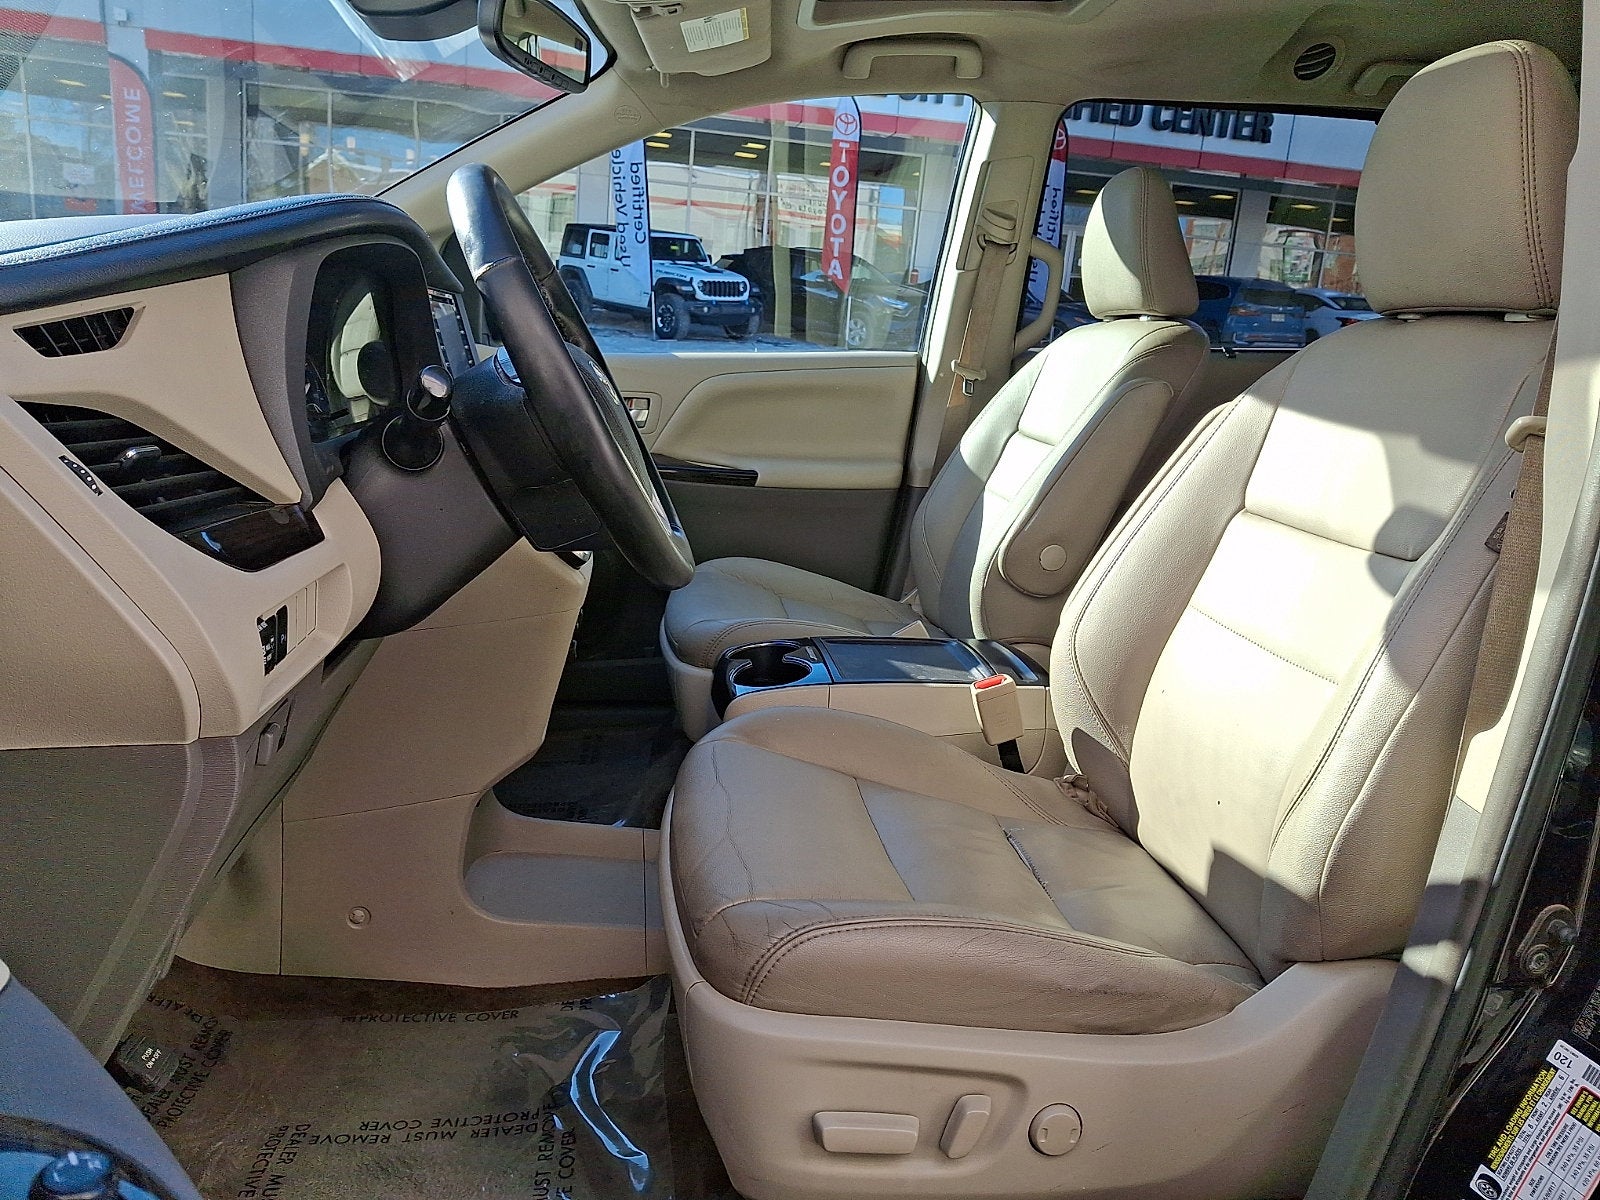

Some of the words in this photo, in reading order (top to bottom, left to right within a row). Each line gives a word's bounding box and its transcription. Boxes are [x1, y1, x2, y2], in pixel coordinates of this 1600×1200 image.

[1151, 105, 1275, 143] CENTER
[828, 142, 850, 279] TOYOTA
[464, 1009, 519, 1022] COVER
[1553, 1051, 1573, 1069] 120
[432, 1107, 540, 1128] PROTECTIVE
[1488, 1146, 1499, 1160] TIRE
[1496, 1133, 1507, 1147] AND
[1504, 1108, 1523, 1135] LOADING
[1520, 1070, 1547, 1109] INFORMATION
[359, 1119, 422, 1131] COVER
[470, 1122, 539, 1139] DEALER
[276, 1123, 311, 1166] DEALER
[309, 1133, 392, 1146] REMOVE
[402, 1130, 457, 1143] MUST
[558, 1126, 577, 1179] COVER
